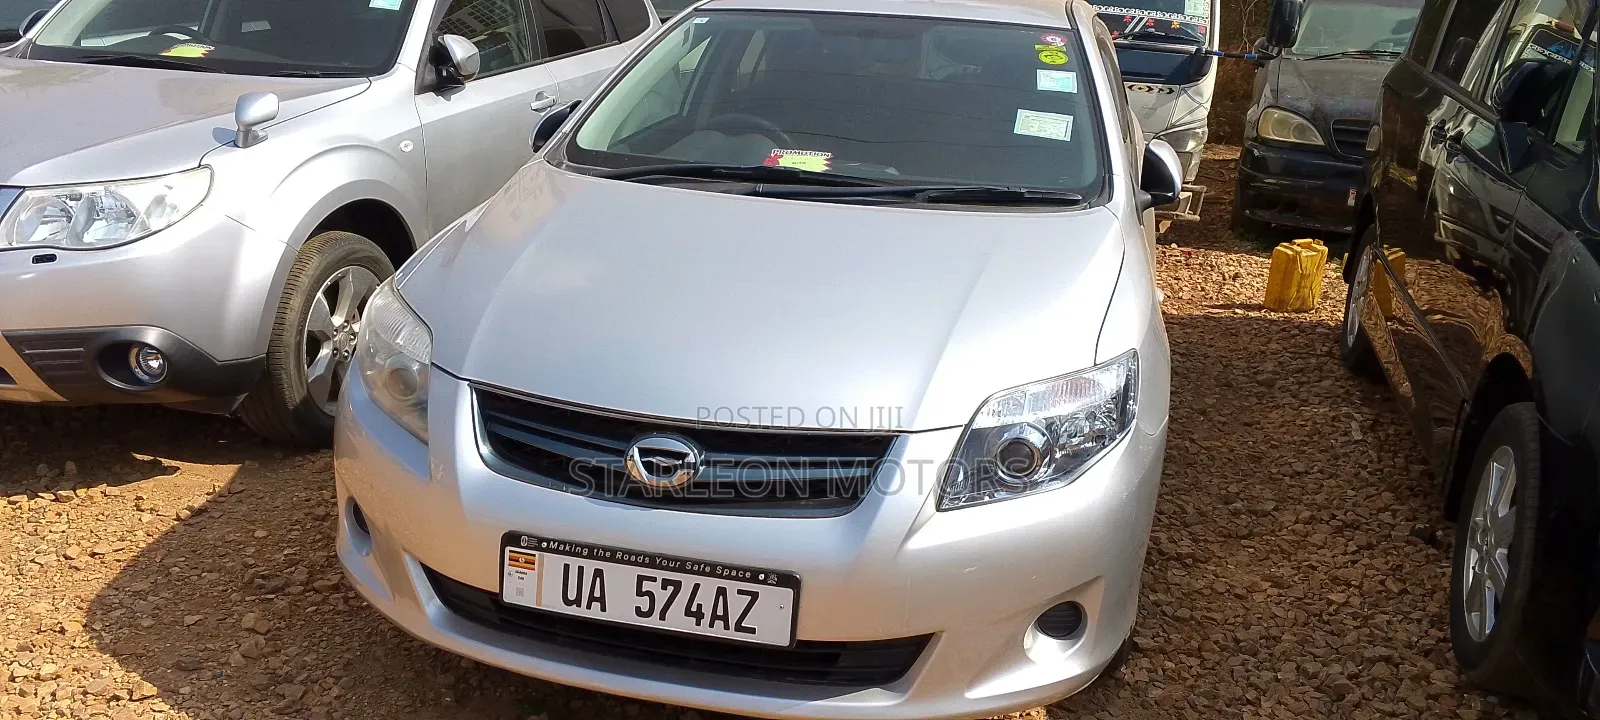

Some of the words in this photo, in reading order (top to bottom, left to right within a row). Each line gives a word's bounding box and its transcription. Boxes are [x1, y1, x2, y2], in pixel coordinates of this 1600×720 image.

[771, 148, 831, 159] PROMOTION
[549, 541, 589, 556] Making
[593, 548, 611, 558] the
[615, 551, 650, 564] Roads
[655, 556, 681, 568] Your
[685, 561, 711, 573] Safe
[716, 566, 751, 578] Space
[561, 562, 607, 613] UA
[634, 573, 760, 635] 574AZ
